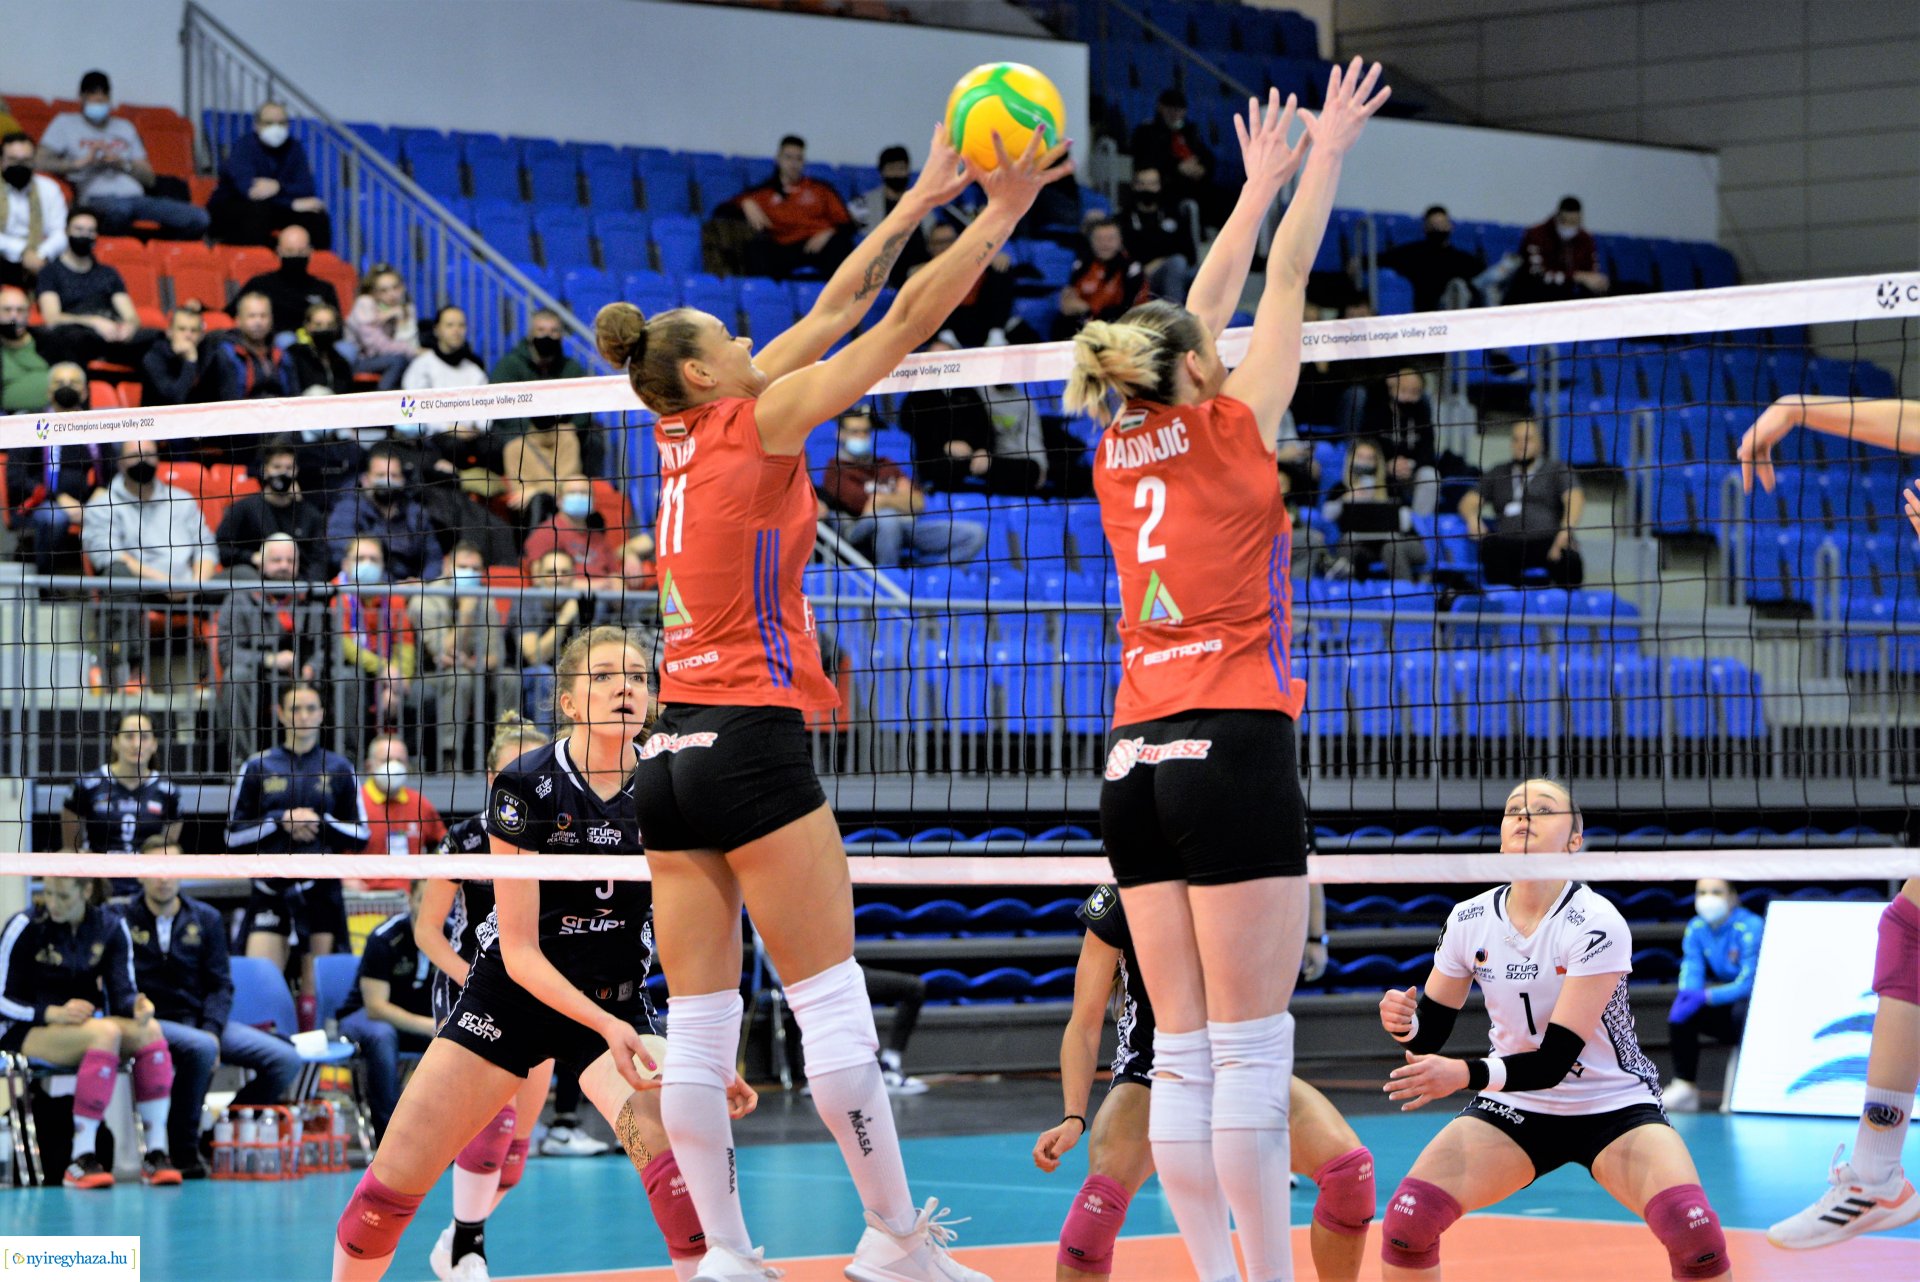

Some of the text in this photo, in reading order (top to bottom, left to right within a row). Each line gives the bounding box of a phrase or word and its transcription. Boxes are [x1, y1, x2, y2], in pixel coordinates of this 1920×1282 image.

[1303, 325, 1448, 346] CEV Champions League Volley 2022
[892, 367, 918, 379] League
[920, 365, 942, 376] Volley
[943, 363, 961, 373] 2022
[420, 393, 533, 409] CEV Champions League Volley 2022
[53, 418, 155, 433] CEV Champions League Volley 2022
[660, 473, 688, 557] 11
[1133, 475, 1167, 564] 2
[1519, 992, 1537, 1036] 1
[848, 1109, 874, 1157] MIKASA
